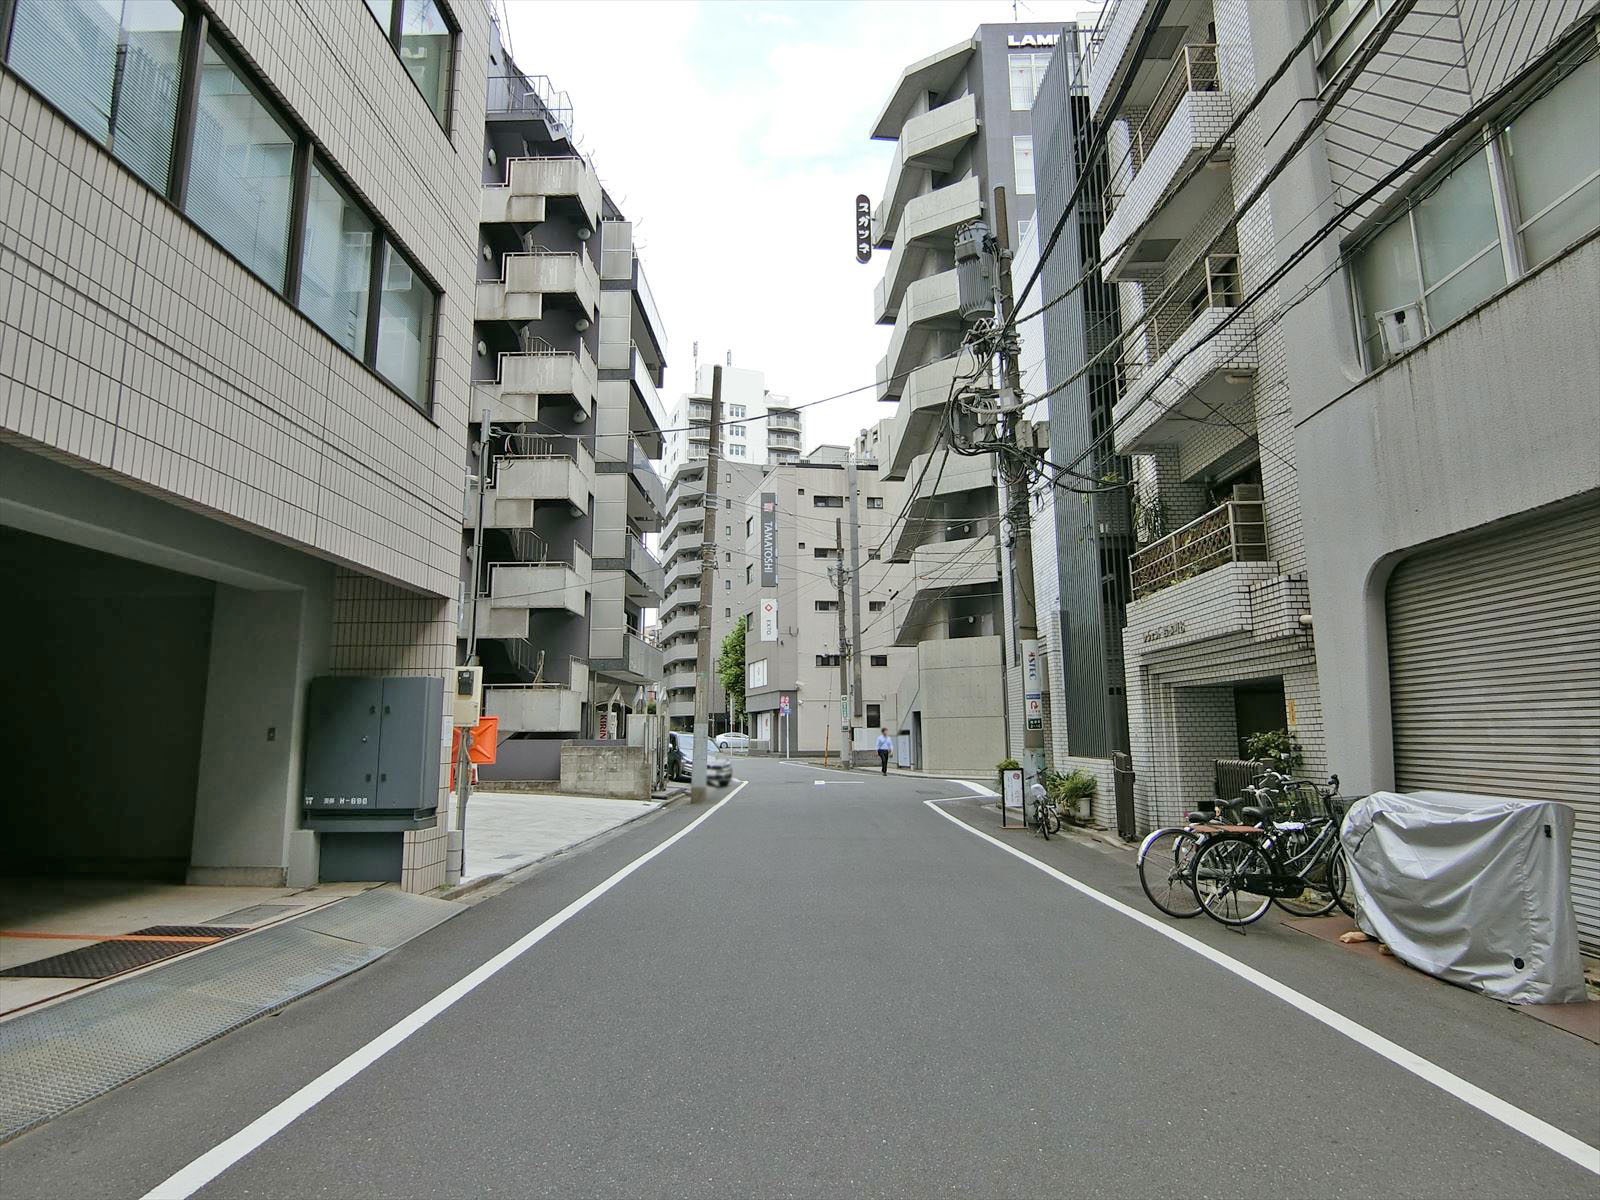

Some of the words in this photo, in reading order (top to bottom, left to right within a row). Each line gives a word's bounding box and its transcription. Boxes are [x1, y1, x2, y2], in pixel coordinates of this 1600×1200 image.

[858, 202, 870, 254] スガツネ
[764, 521, 773, 573] TAMATOSHI
[600, 714, 608, 740] KIRIN
